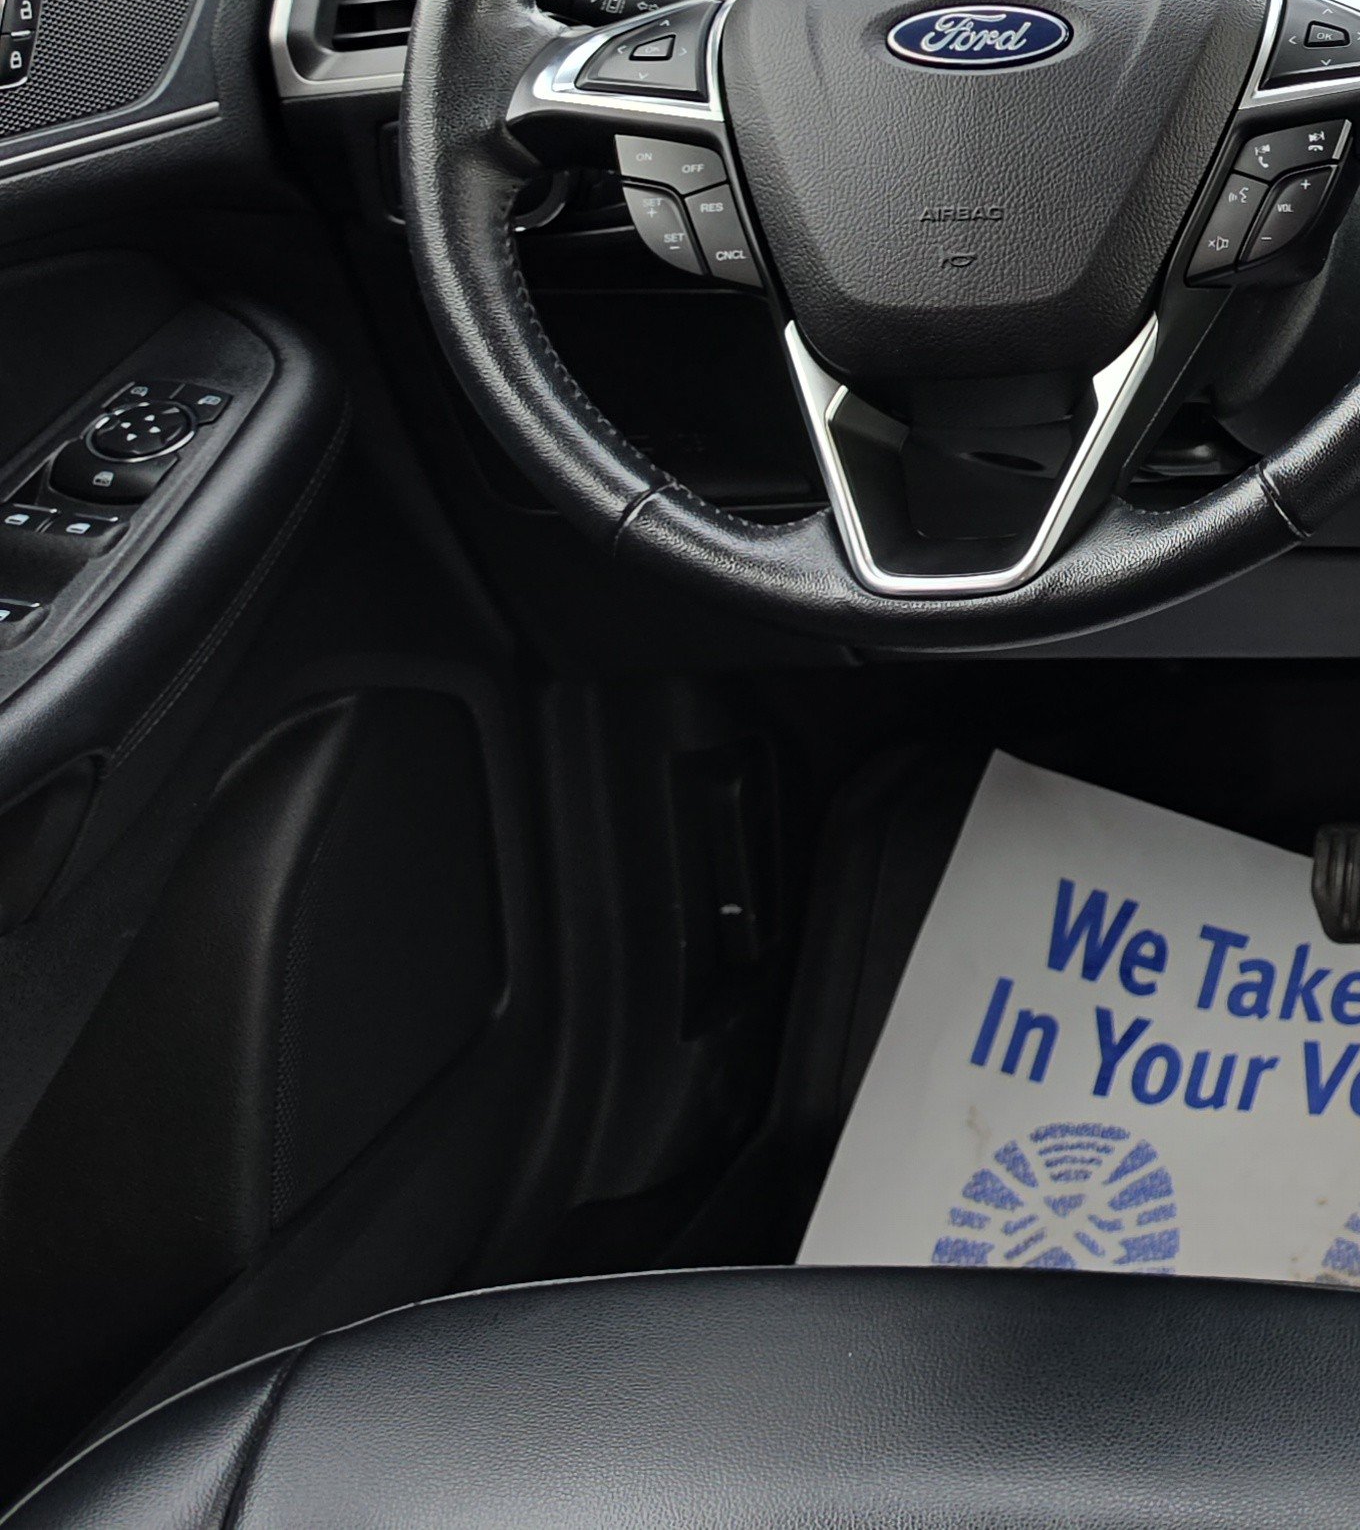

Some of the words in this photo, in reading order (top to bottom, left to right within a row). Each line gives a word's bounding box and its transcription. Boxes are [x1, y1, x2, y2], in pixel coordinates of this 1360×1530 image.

[921, 13, 1031, 52] Ford
[1316, 32, 1333, 41] OK
[636, 152, 652, 162] ON
[681, 164, 705, 174] OFF
[642, 197, 663, 207] SET
[700, 202, 724, 213] RES
[1277, 203, 1294, 213] VOL
[919, 207, 1005, 223] AIRBAG
[663, 233, 685, 244] SET
[716, 250, 747, 261] CNCL
[1045, 878, 1169, 996] We
[969, 976, 1060, 1084] In
[1092, 1006, 1277, 1115] Your
